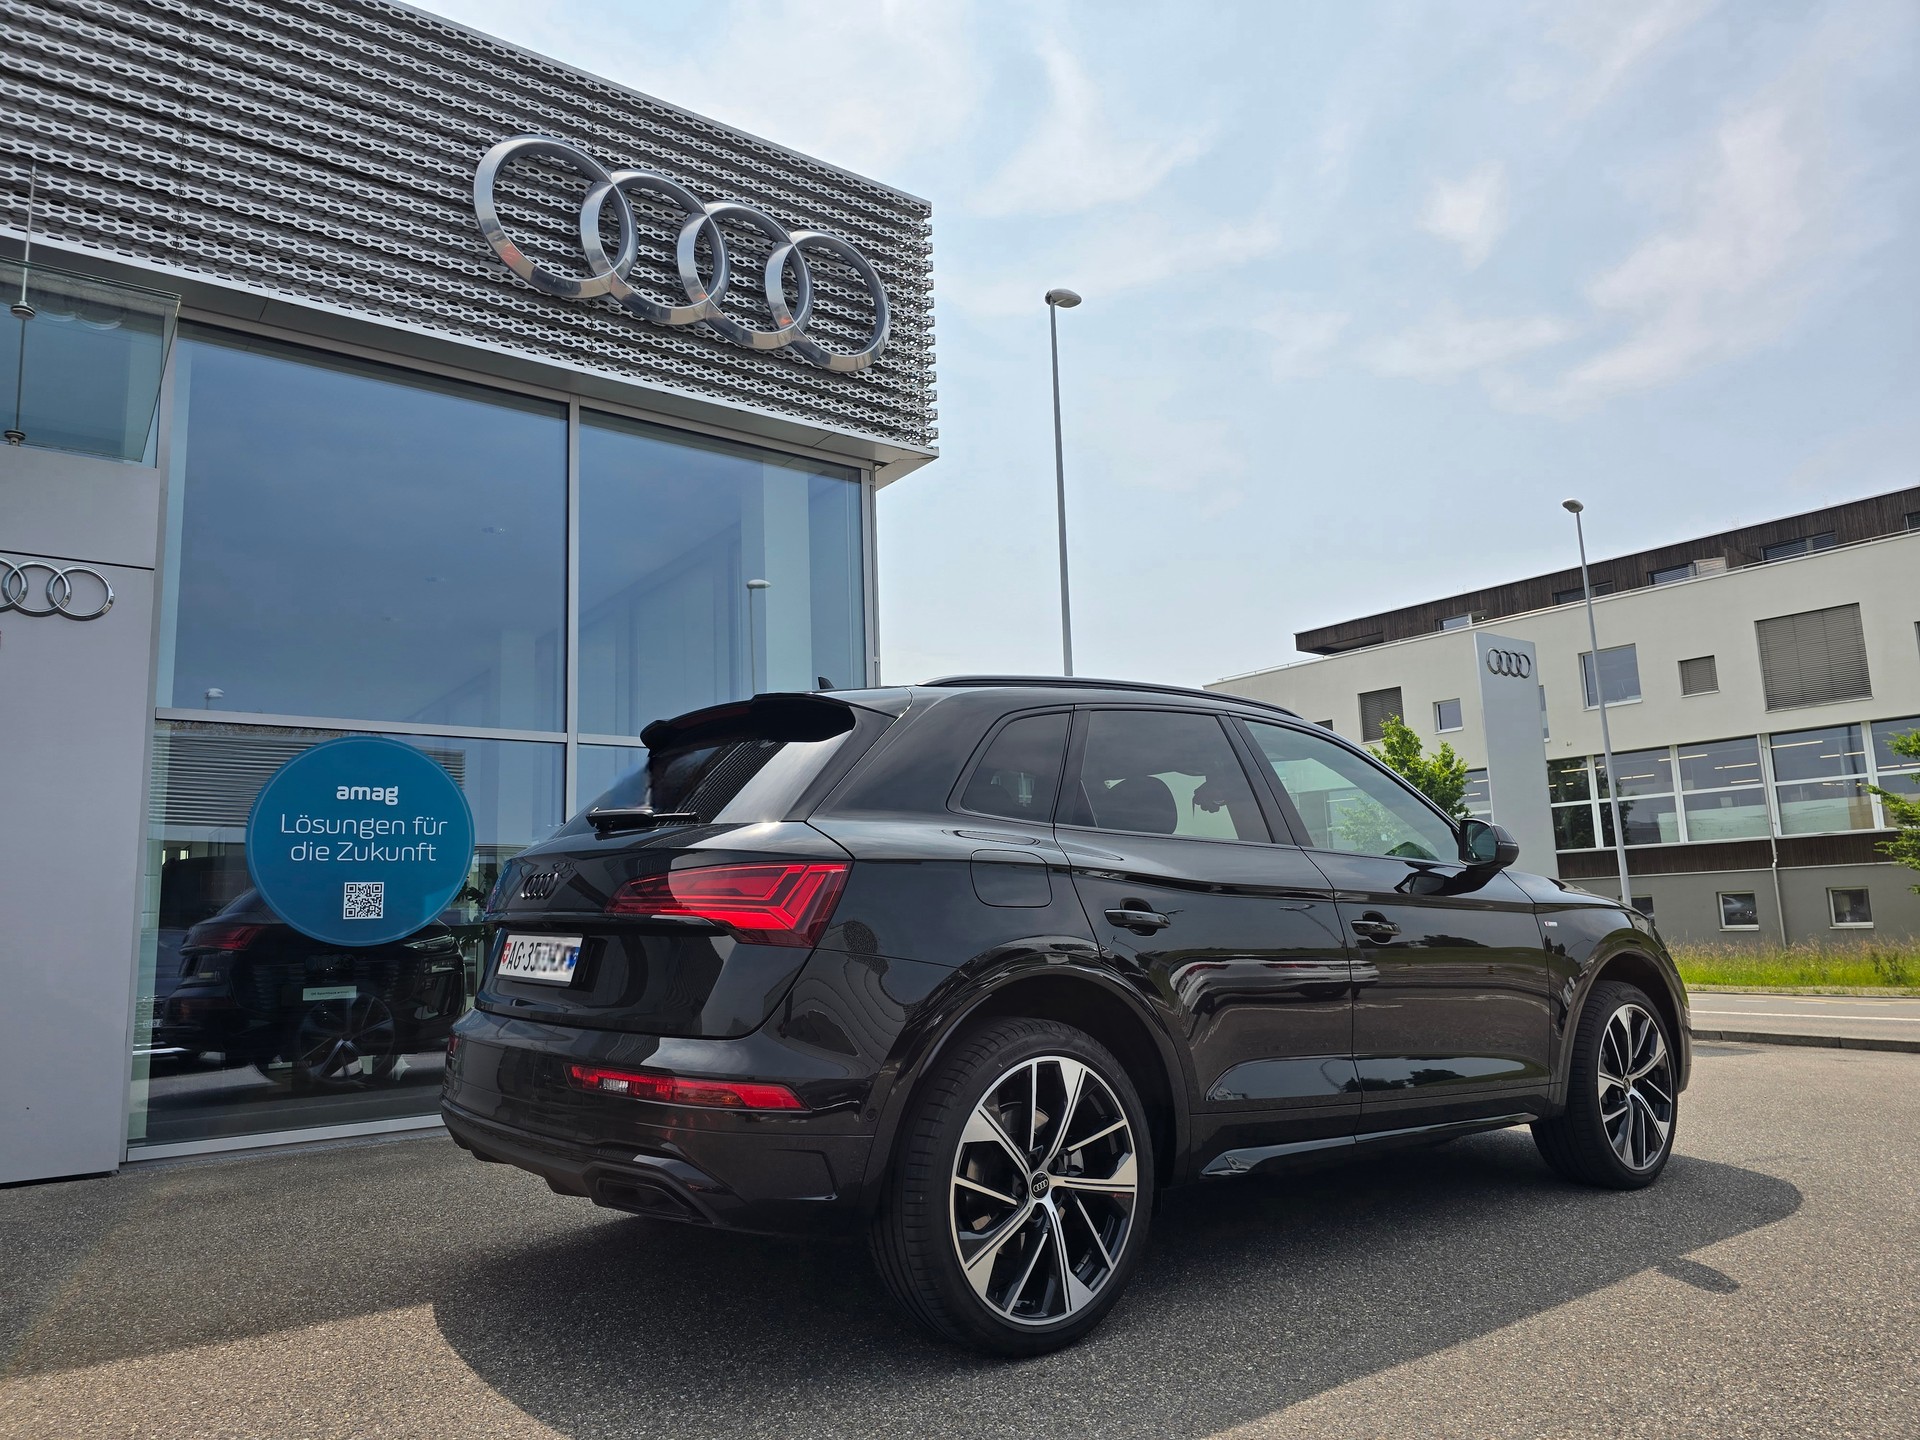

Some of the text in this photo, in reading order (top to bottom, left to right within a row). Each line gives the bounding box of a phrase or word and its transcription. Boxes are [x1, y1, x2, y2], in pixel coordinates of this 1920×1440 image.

[336, 785, 399, 805] amag
[281, 814, 448, 839] Lösungen für
[290, 841, 437, 862] die Zukunft
